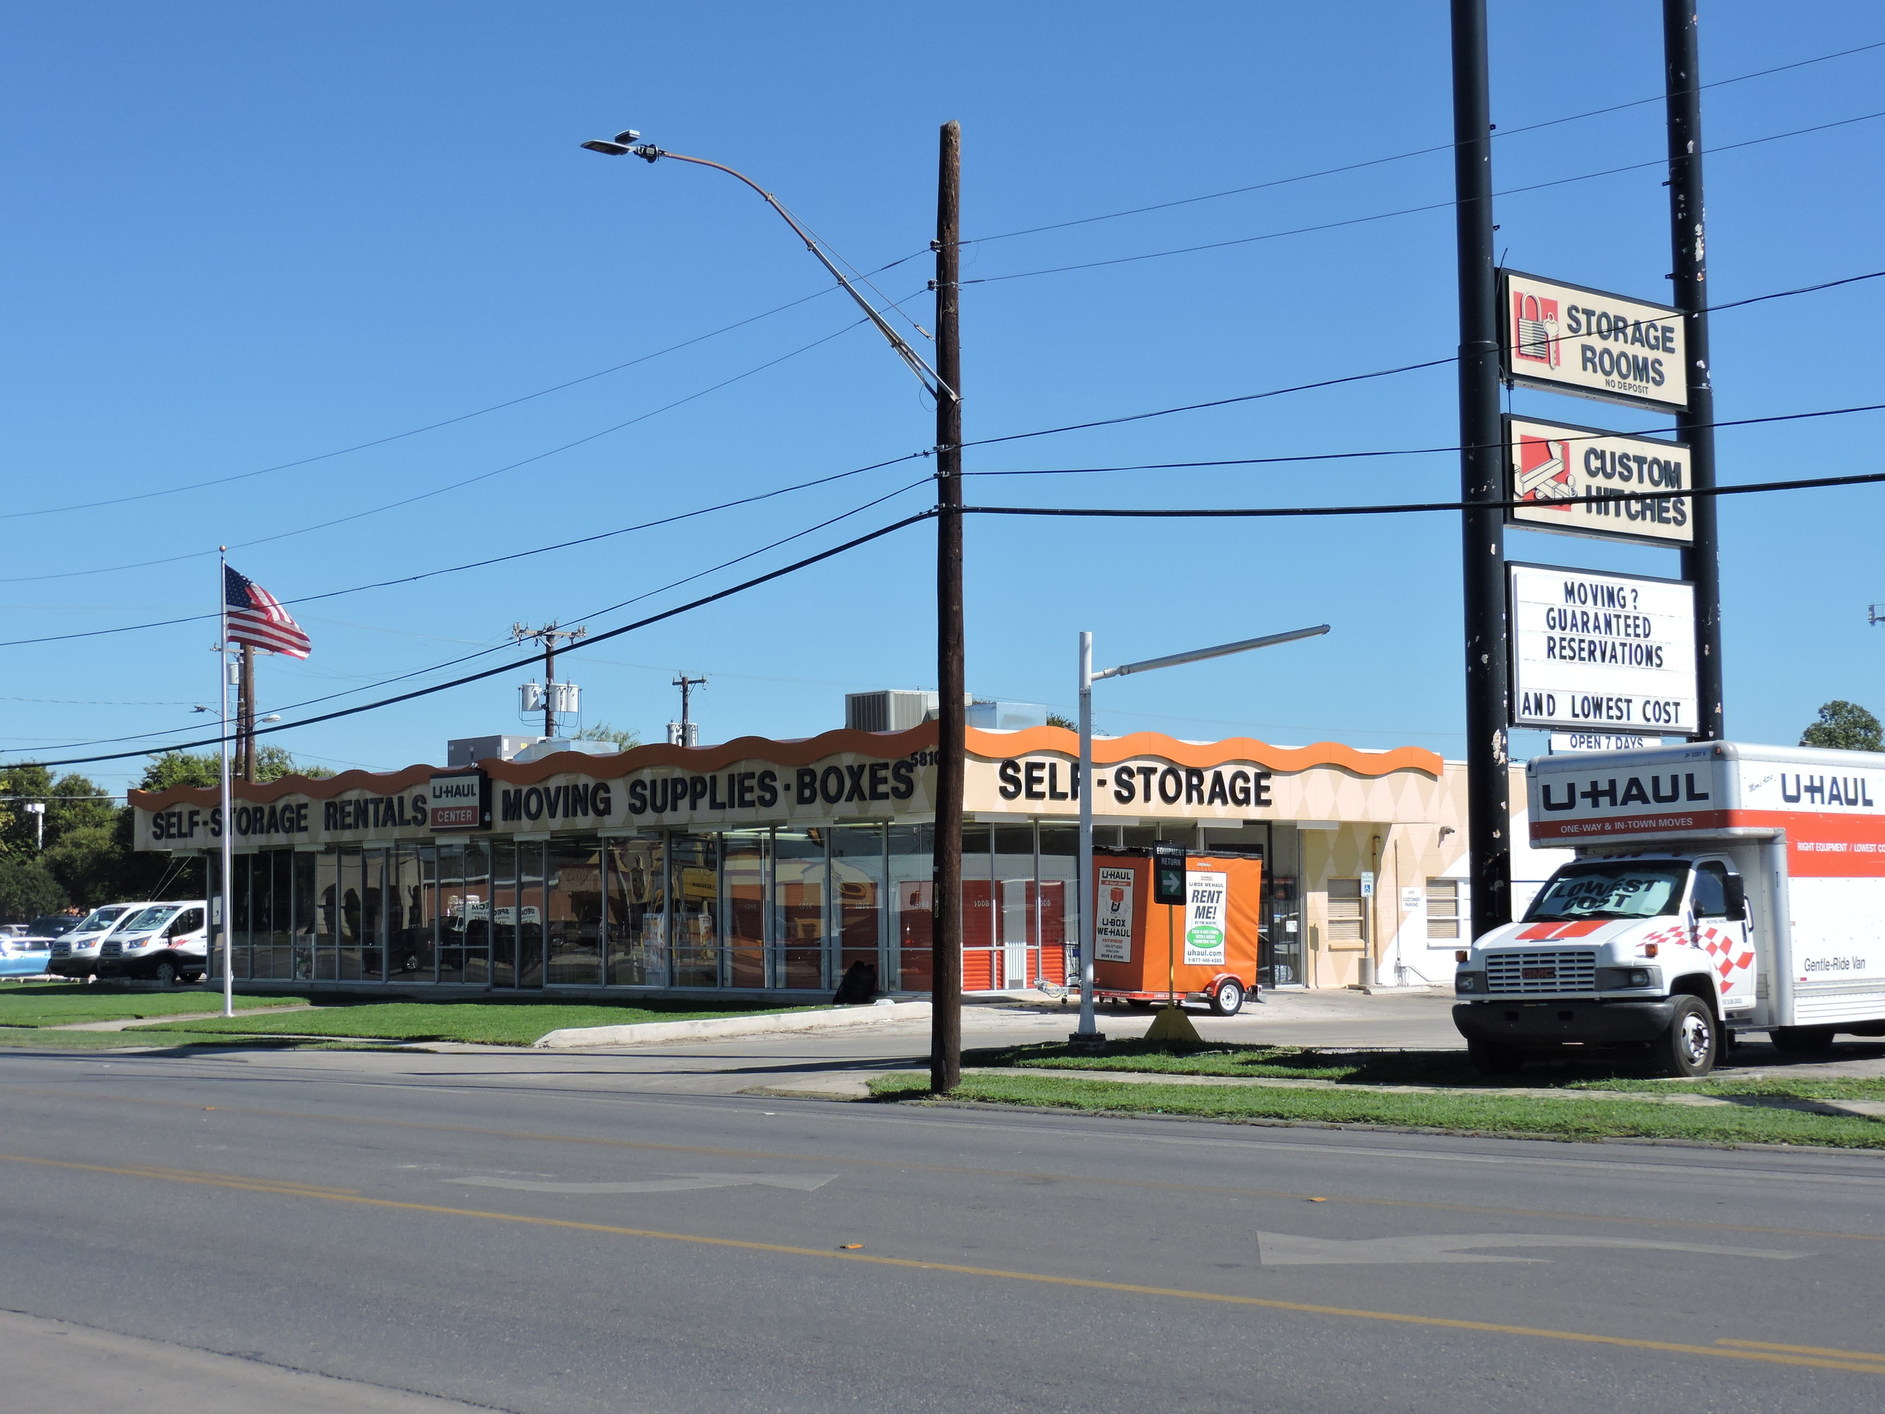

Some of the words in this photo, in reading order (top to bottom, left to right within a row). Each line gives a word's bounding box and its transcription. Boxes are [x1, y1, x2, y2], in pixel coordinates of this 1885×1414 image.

[1567, 304, 1676, 354] STORAGE
[1581, 343, 1665, 387] ROOMS
[1605, 378, 1616, 389] NO
[1617, 381, 1649, 396] DEPOSIT
[1584, 447, 1682, 490] CUSTOM
[1585, 484, 1688, 527] HITCHES
[1546, 607, 1651, 639] GUARANTEED
[1546, 635, 1664, 668] RESERVATIONS
[1521, 692, 1556, 717] AND
[1571, 695, 1632, 721] LOWEST
[1642, 699, 1681, 724] COST
[1570, 734, 1601, 749] OPEN
[1605, 736, 1611, 750] 7
[1615, 736, 1644, 750] DAYS
[432, 783, 476, 799] U-HAUL
[1542, 773, 1709, 811] U-HAUL
[1781, 773, 1873, 807] U-HAUL
[501, 783, 611, 822] MOVING
[324, 794, 427, 831] RENTALS
[437, 809, 473, 823] CENTER
[1560, 823, 1602, 834] ONE-WAY
[1604, 822, 1612, 831] &
[1614, 820, 1656, 830] IN-TOWN
[1658, 817, 1694, 827] MOVES
[1156, 846, 1184, 856] EQUIPMENT
[1797, 842, 1815, 851] RIGHT
[1815, 842, 1848, 852] EQUIPMENT
[1853, 843, 1877, 853] LOWEST
[1101, 870, 1131, 880] U-HAUL
[1191, 889, 1223, 904] RENT
[1552, 878, 1660, 898] LOWEST
[1194, 905, 1217, 920] ME!
[1102, 918, 1126, 927] U-BOX
[1187, 949, 1222, 957] uhaul.com
[1804, 956, 1850, 972] Gentle-Ride
[1851, 956, 1866, 970] Van
